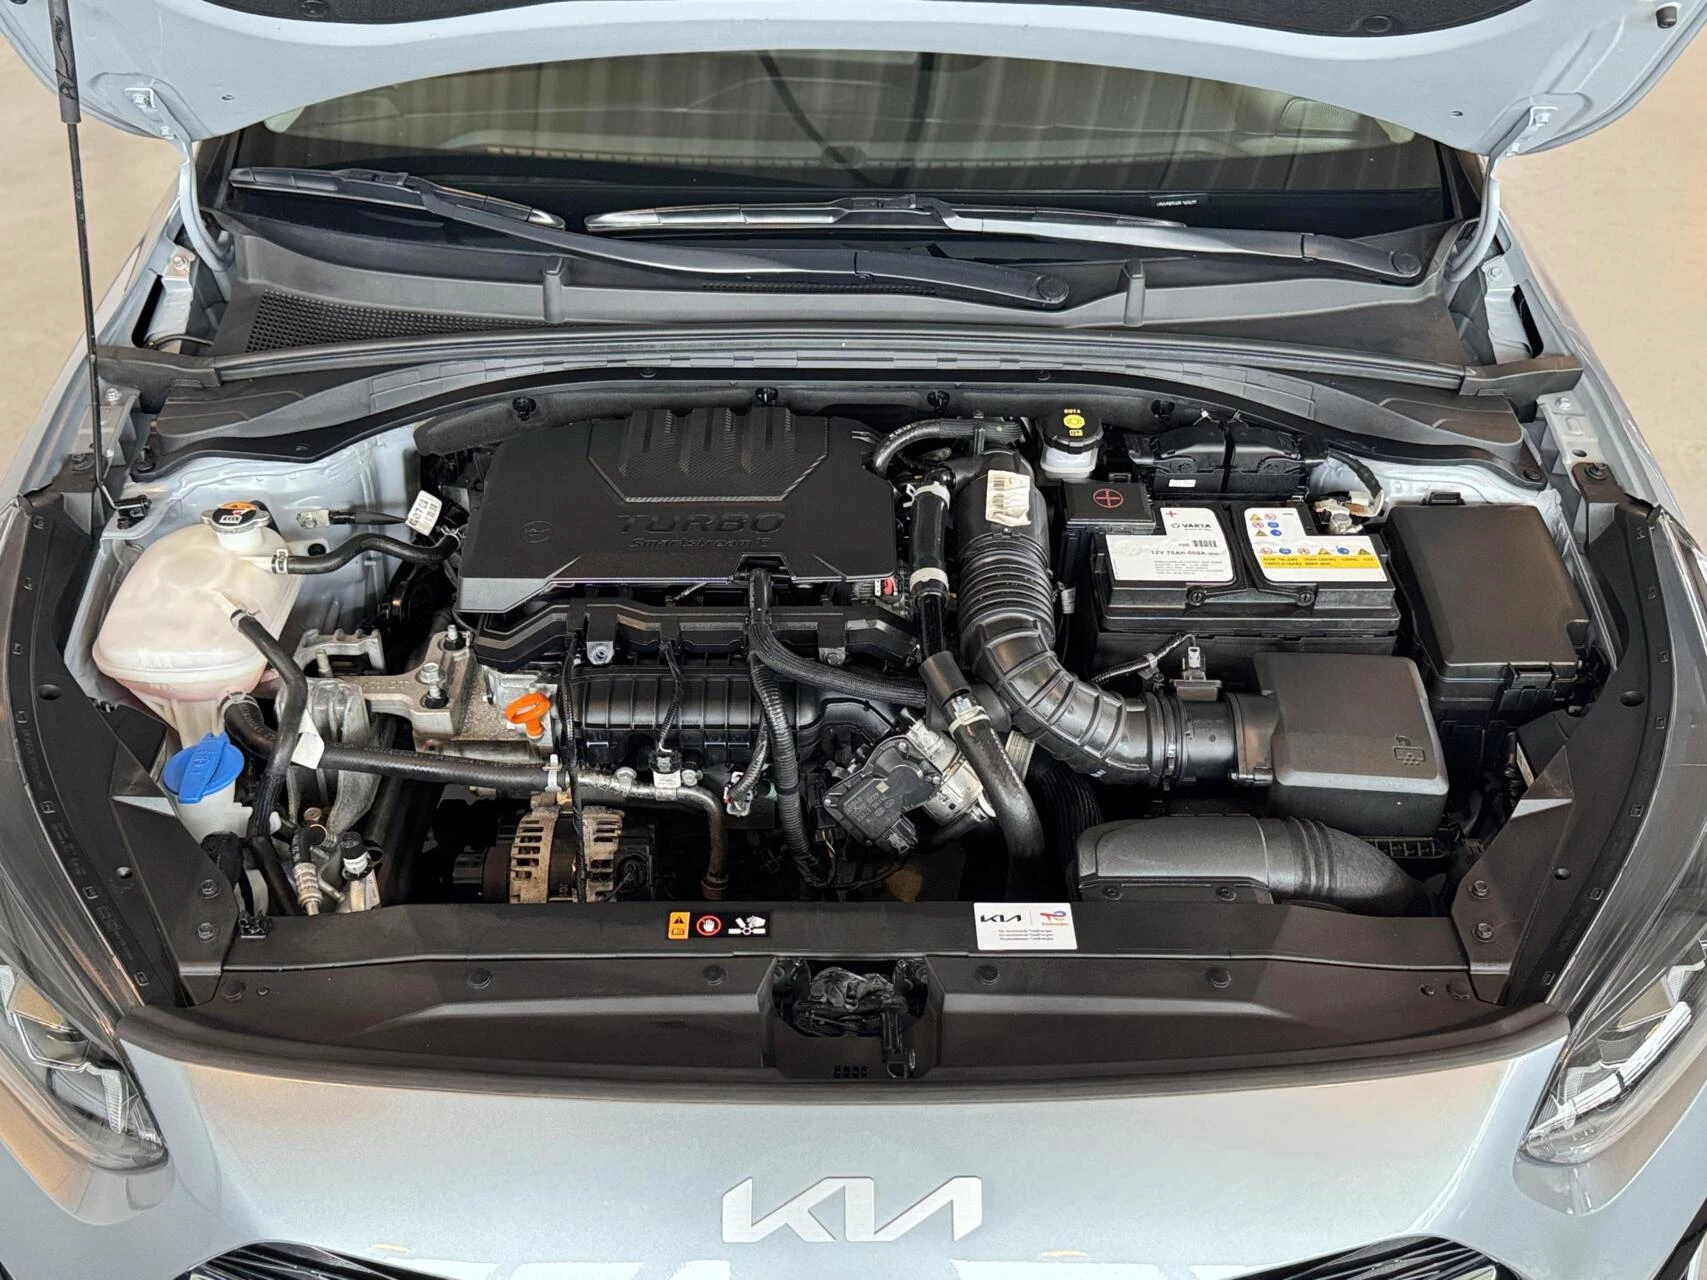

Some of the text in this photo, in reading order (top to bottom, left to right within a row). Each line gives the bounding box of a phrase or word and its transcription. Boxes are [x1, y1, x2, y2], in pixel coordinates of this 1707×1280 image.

[615, 512, 786, 534] TURBO
[628, 536, 754, 548] Smartstream
[980, 913, 1022, 923] KIA
[721, 1176, 983, 1243] KIA
